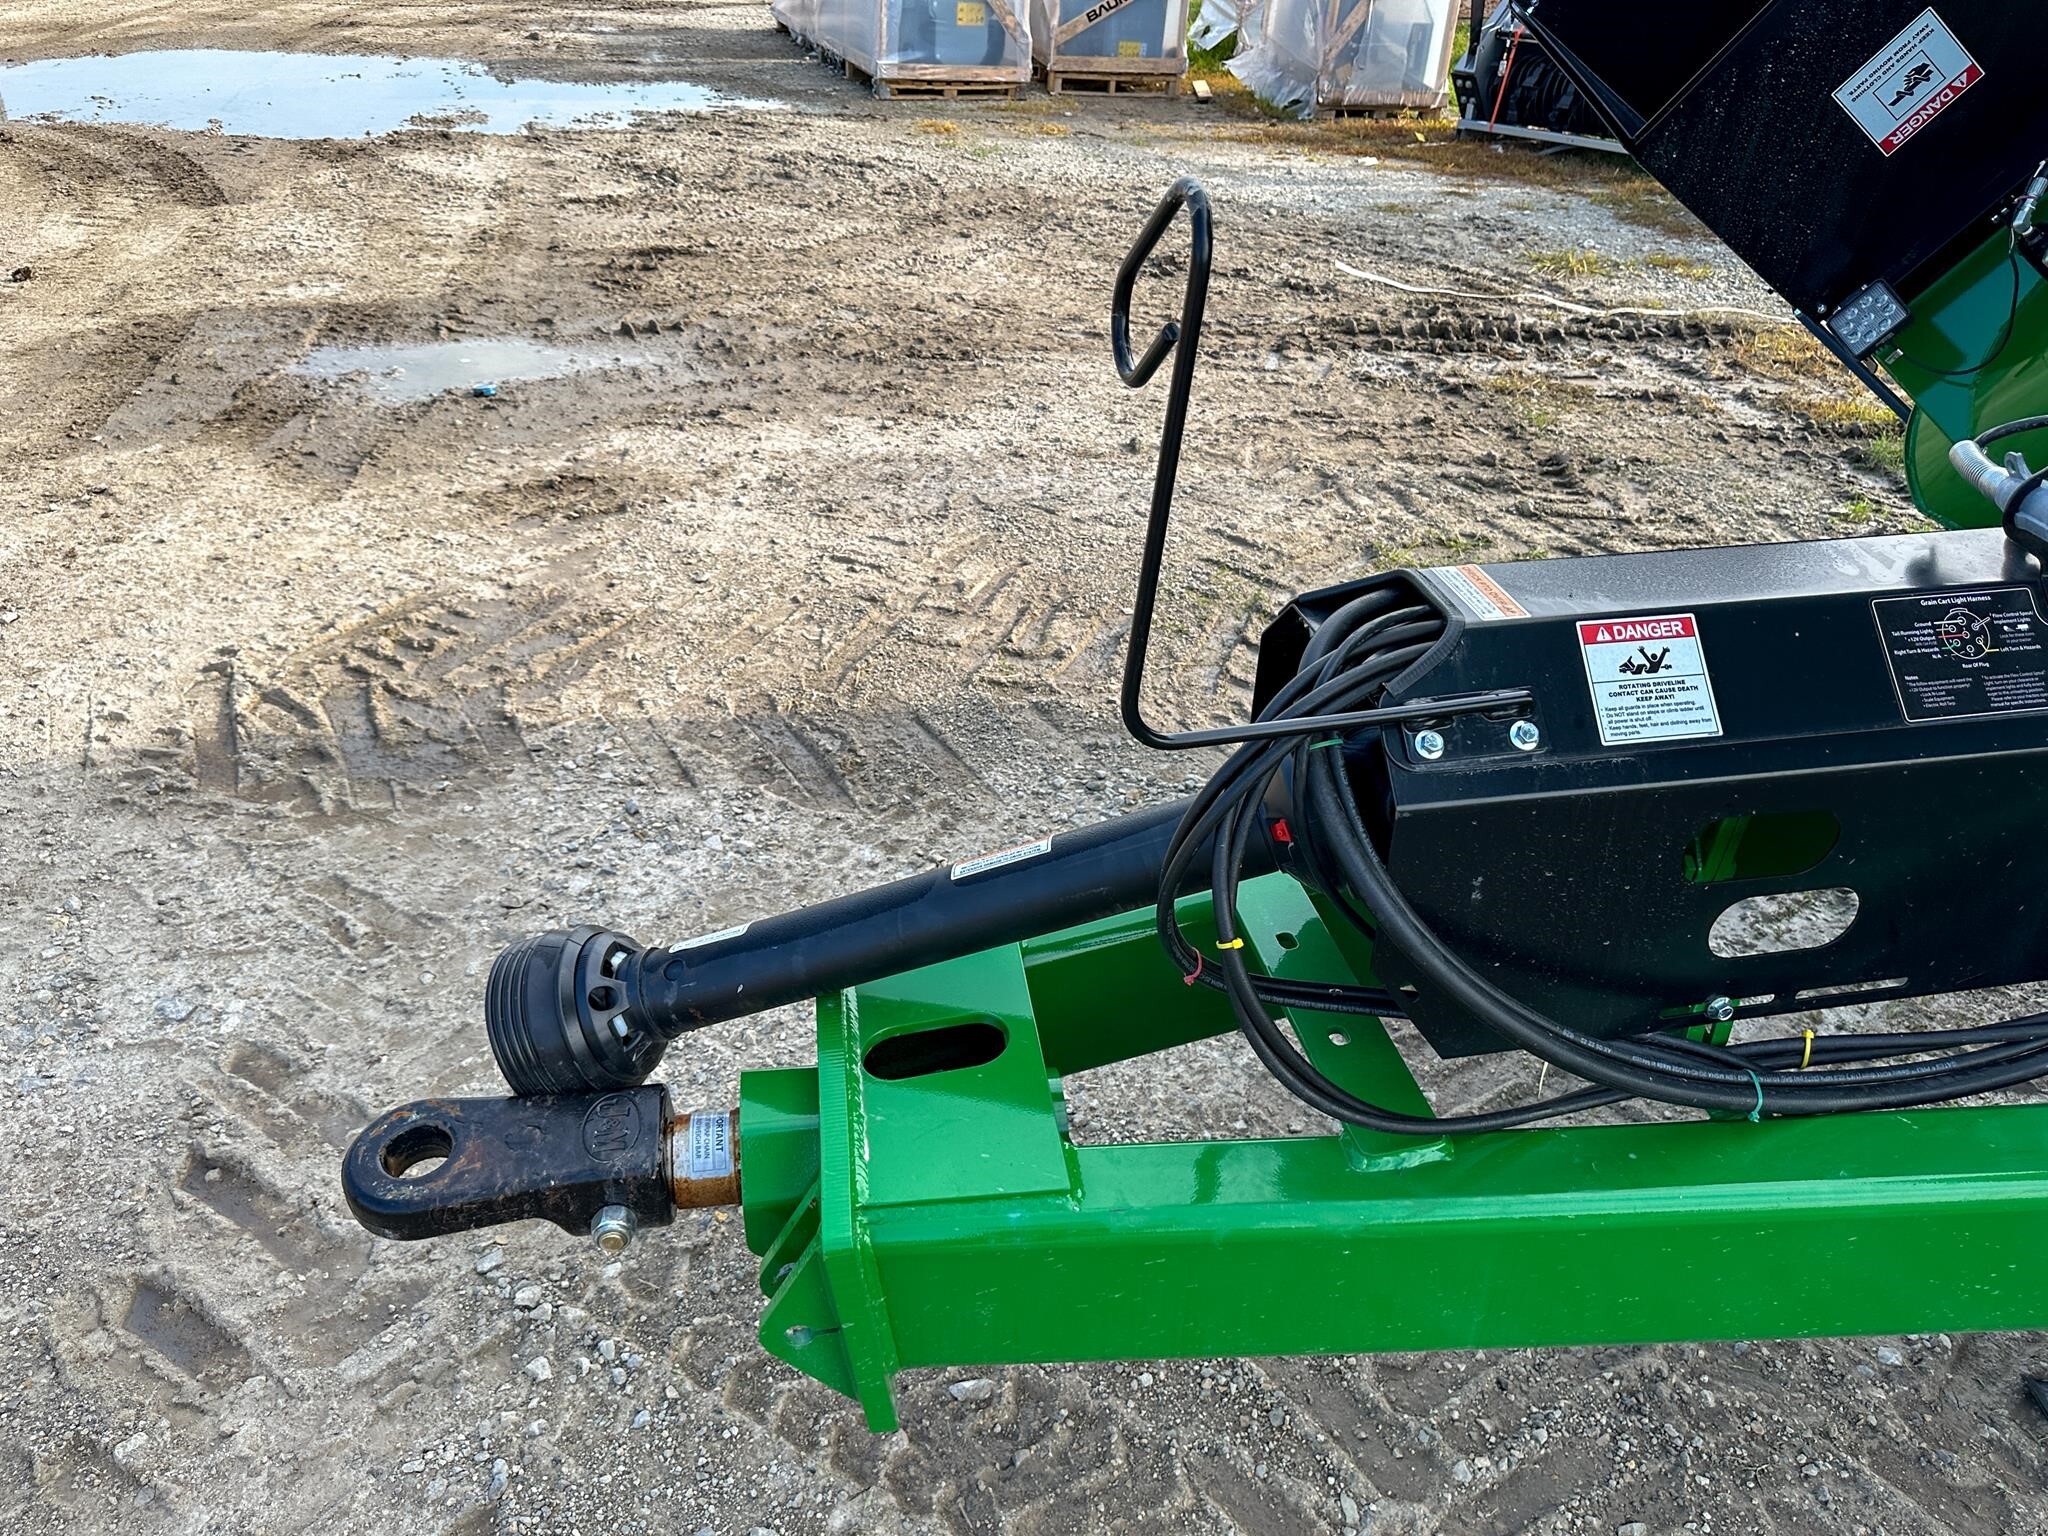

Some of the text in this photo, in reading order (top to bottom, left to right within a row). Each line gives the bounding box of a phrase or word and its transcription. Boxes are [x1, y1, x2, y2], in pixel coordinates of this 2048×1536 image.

[1846, 23, 1929, 97] AWAY FROM MOVING PARTS.
[1850, 27, 1934, 102] KEEP HANDS AND CLOTHING
[1888, 87, 1953, 145] DANGER
[1612, 620, 1684, 639] DANGER
